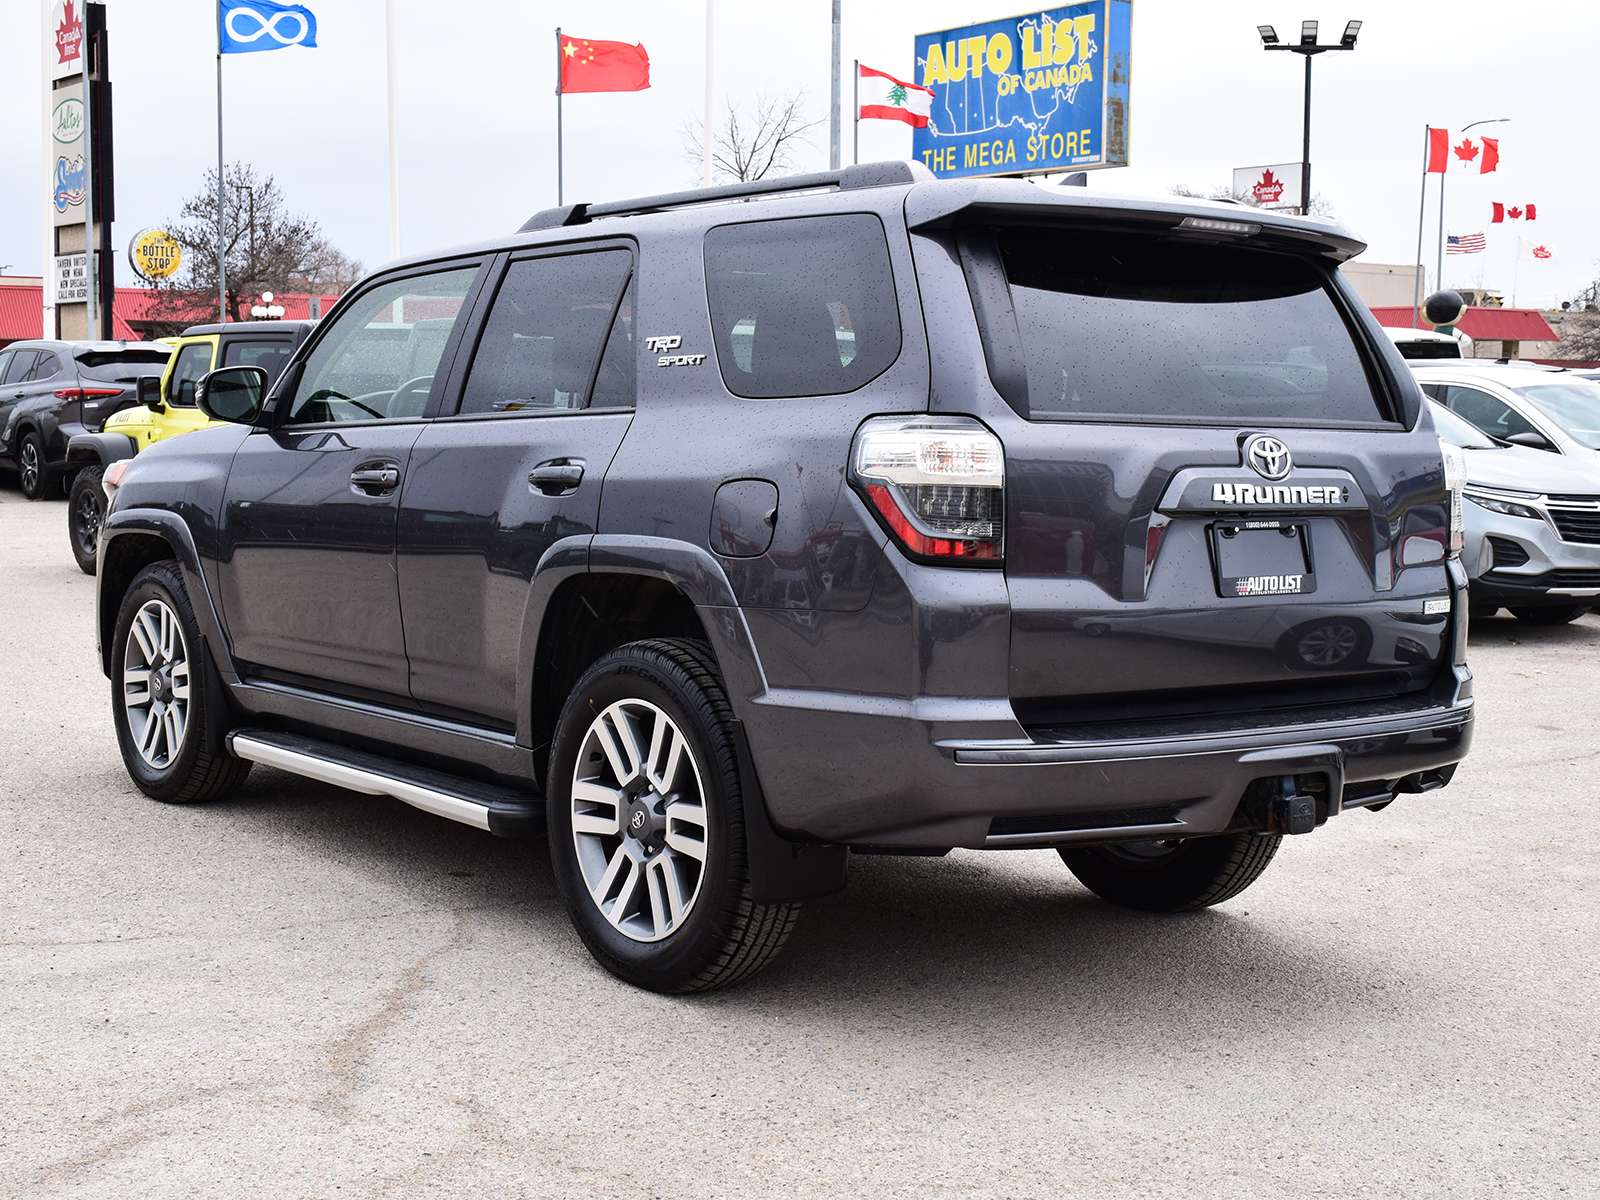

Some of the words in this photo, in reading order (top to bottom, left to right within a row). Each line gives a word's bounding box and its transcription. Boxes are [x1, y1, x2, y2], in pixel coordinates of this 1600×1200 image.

[923, 32, 1013, 87] AUTO
[1022, 14, 1095, 70] LIST
[997, 75, 1020, 97] OF
[1025, 62, 1094, 92] CANADA
[922, 147, 957, 172] THE
[964, 139, 1016, 168] MEGA
[1026, 129, 1092, 162] STORE
[142, 245, 175, 257] BOTTLE
[147, 257, 171, 270] STOP
[62, 269, 70, 279] NEW
[60, 280, 68, 289] NEW
[645, 335, 682, 353] TRD
[657, 354, 706, 367] SPORT
